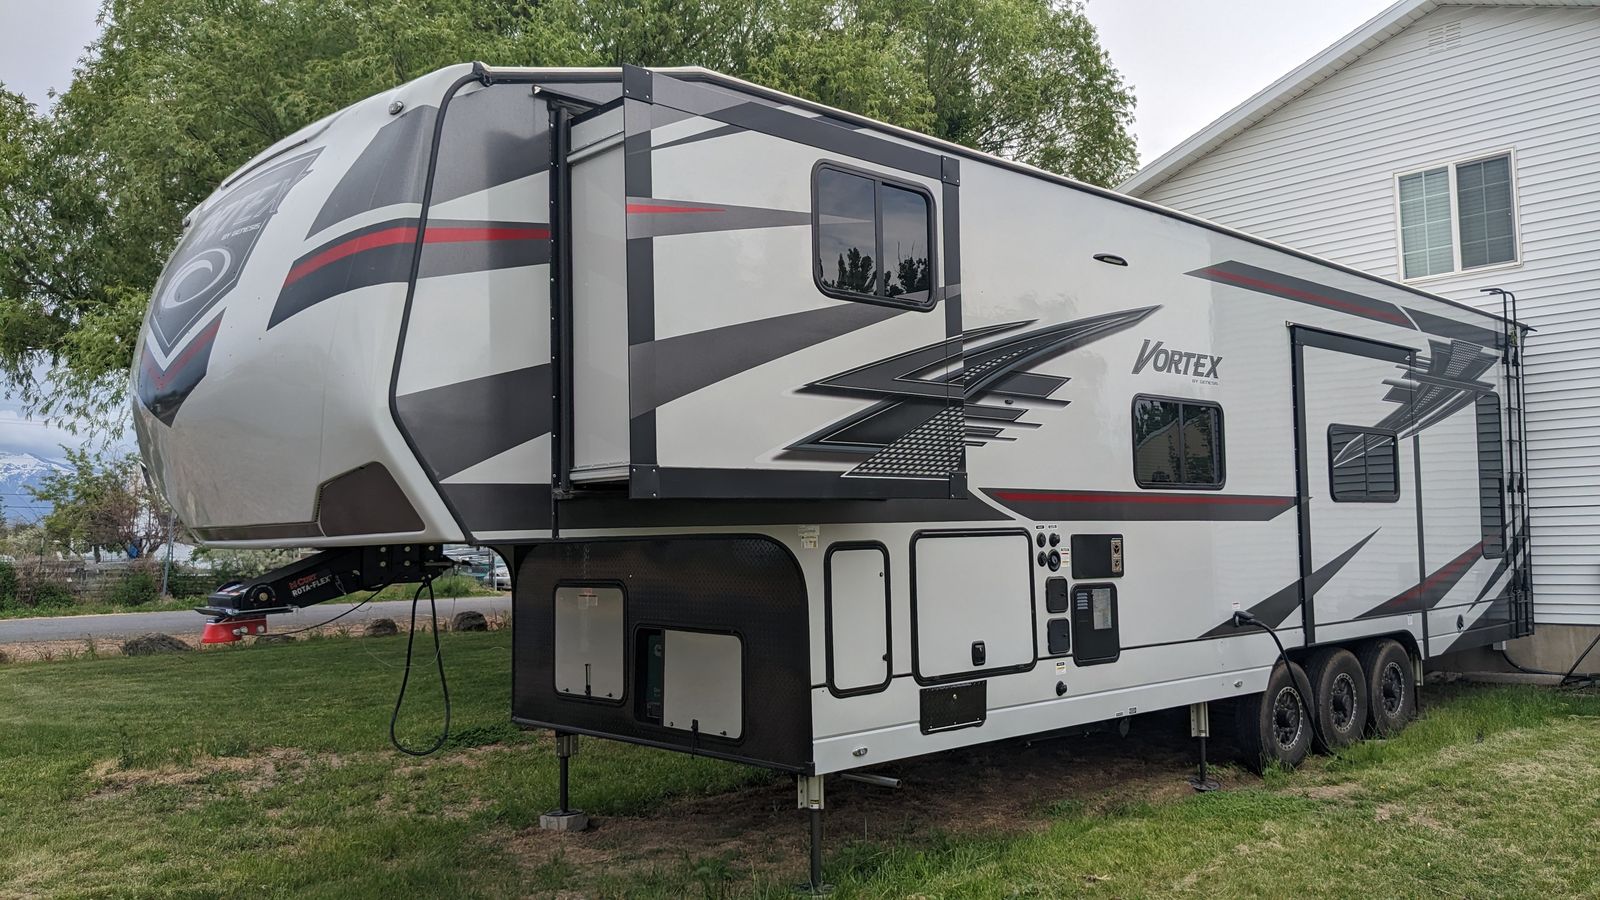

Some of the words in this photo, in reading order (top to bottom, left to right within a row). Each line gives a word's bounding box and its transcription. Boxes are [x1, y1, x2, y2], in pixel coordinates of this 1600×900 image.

[221, 231, 231, 240] BY
[1131, 338, 1223, 379] VORTEX
[292, 576, 331, 597] ROTA-FLEX
